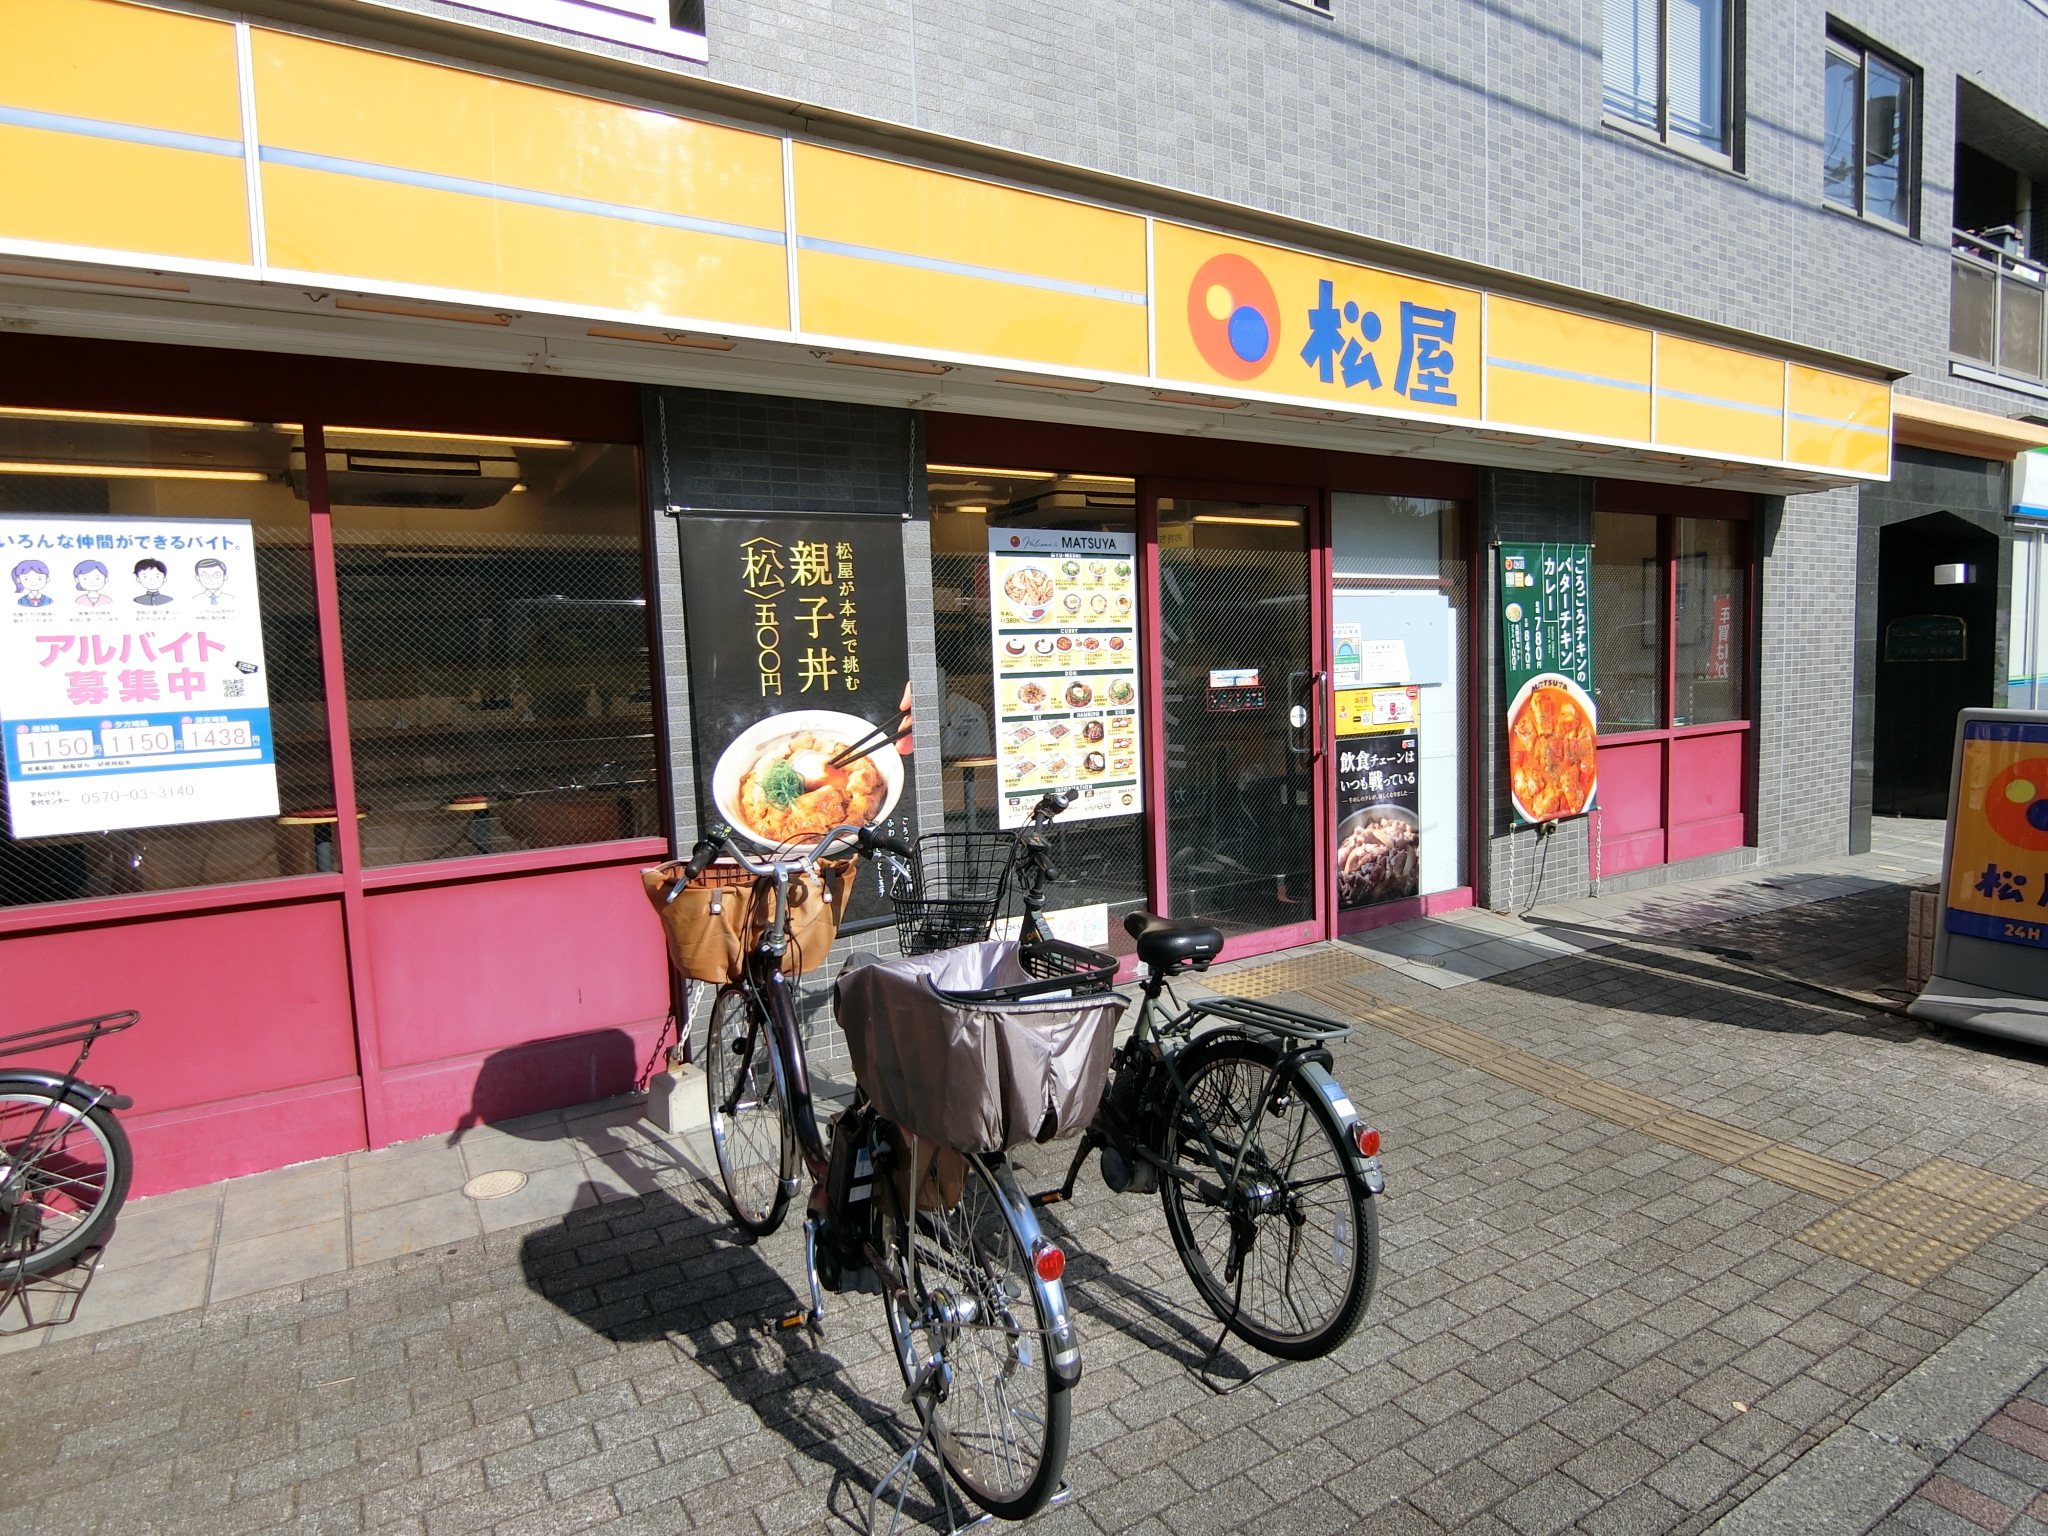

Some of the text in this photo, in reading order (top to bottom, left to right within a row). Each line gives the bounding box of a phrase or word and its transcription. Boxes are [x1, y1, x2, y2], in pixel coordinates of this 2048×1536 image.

[1300, 279, 1457, 407] 松屋
[0, 534, 241, 550] いろんな仲間ができるバイト。
[1062, 537, 1117, 550] MATSUYA
[1544, 556, 1556, 612] カレー
[788, 540, 839, 694] 親子丼
[835, 541, 860, 692] 松屋が本気で挑む
[1558, 556, 1573, 667] バターチキン
[1060, 627, 1079, 635] CURRY
[36, 631, 226, 668] アルバイト
[64, 667, 207, 706] 募集中
[26, 737, 89, 759] 1150
[111, 732, 169, 754] 1150
[191, 727, 247, 748] 1438
[1339, 750, 1416, 774] 飲食チェーンは
[1340, 770, 1416, 792] いつも戦っている
[81, 784, 195, 805] 0570-03-3140
[1974, 863, 2048, 907] 松
[2004, 923, 2041, 940] 24H
